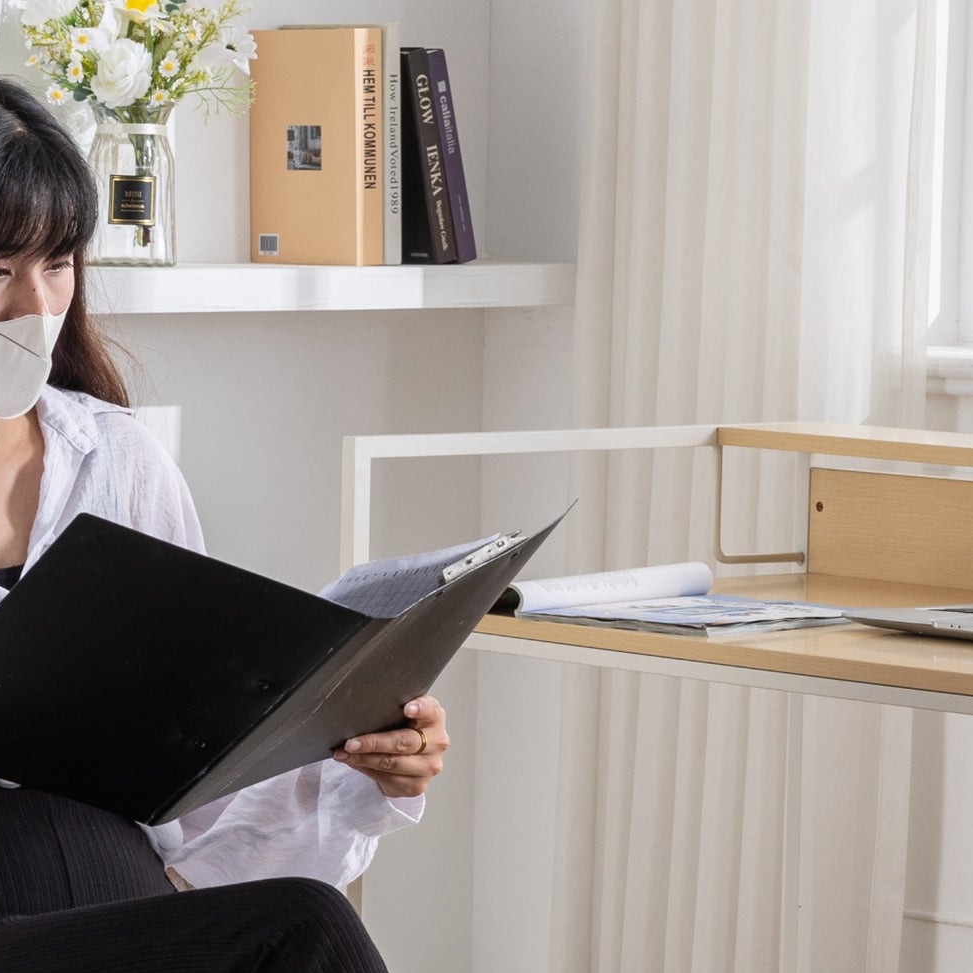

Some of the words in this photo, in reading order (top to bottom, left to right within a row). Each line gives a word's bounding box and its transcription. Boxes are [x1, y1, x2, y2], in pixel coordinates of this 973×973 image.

[363, 69, 376, 94] HEM
[390, 74, 398, 102] How
[363, 95, 376, 120] TILL
[363, 123, 377, 190] KOMMUNEN
[426, 144, 443, 197] IENKA
